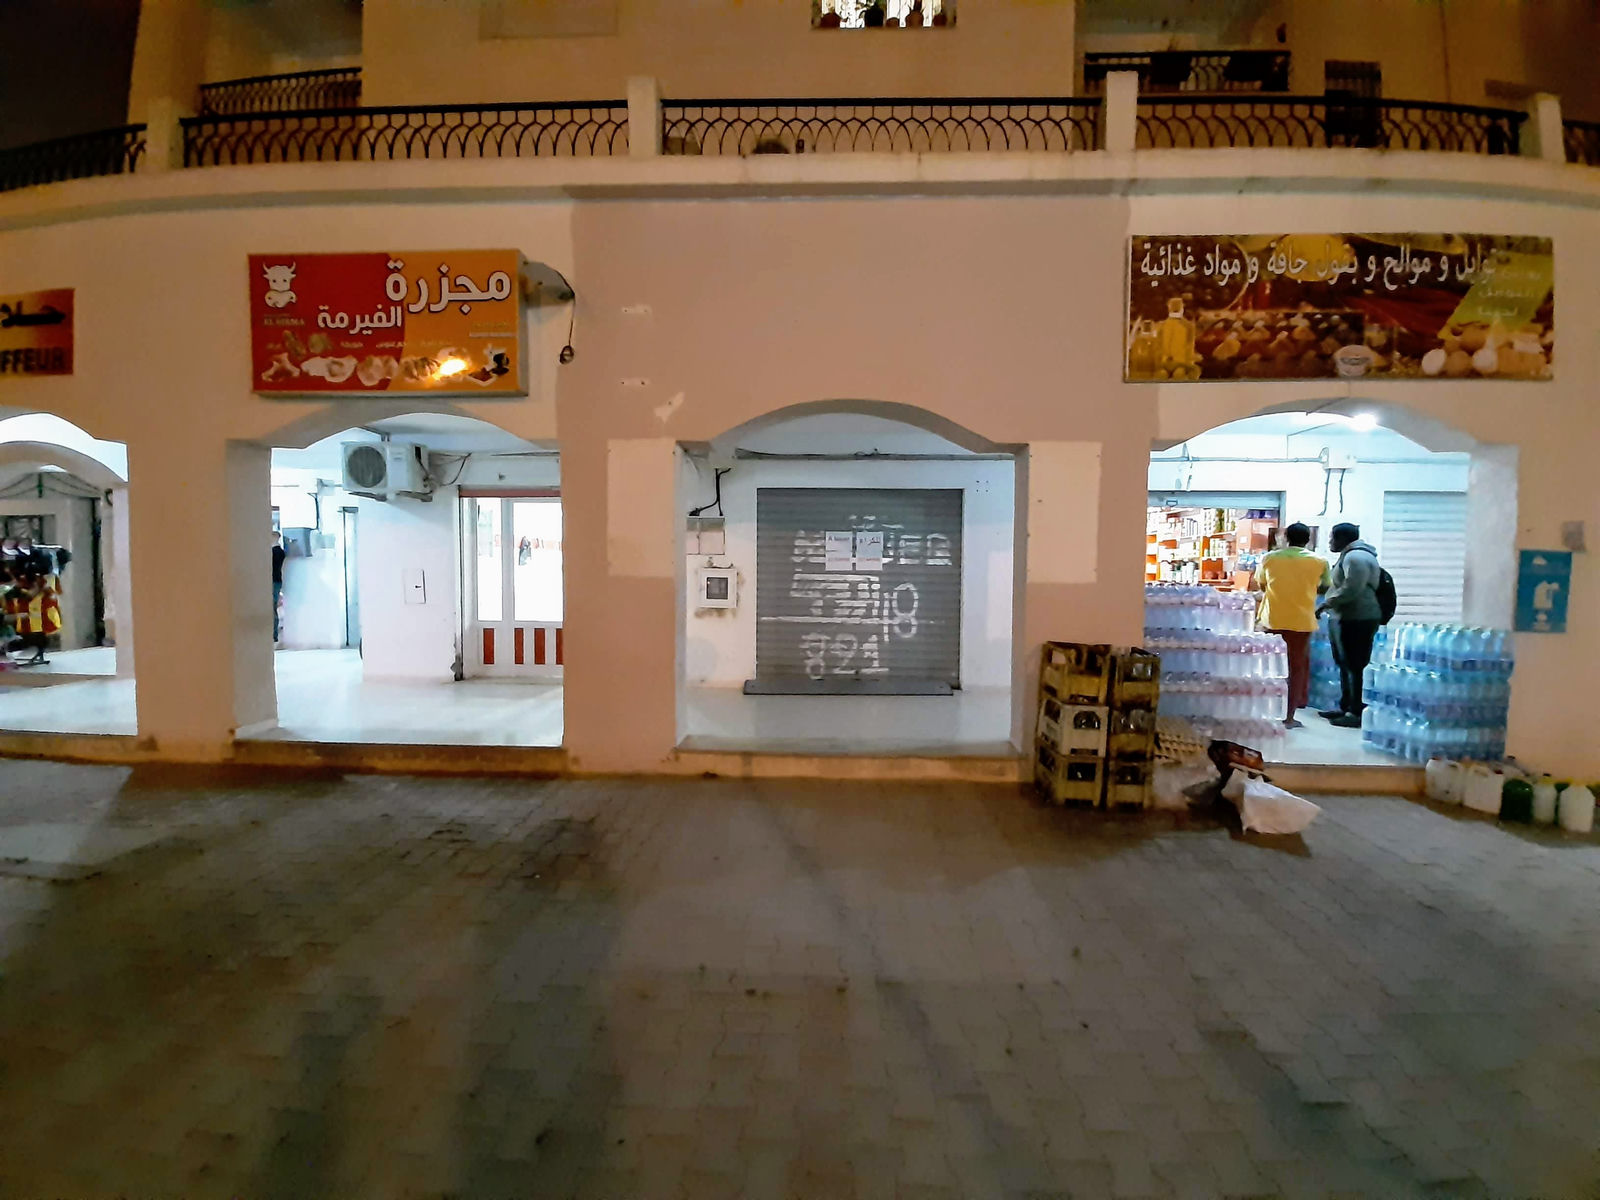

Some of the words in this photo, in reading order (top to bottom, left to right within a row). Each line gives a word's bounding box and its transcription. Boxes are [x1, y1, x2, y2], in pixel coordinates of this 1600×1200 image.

[1140, 242, 1197, 287] غذائية
[1203, 242, 1241, 287] مواد
[1246, 254, 1259, 283] و
[1267, 241, 1308, 284] جافة
[1363, 254, 1377, 283] و
[1383, 242, 1432, 291] موالح
[1437, 254, 1449, 282] و
[385, 258, 511, 314] مجزرة
[317, 304, 403, 335] الفيرمة
